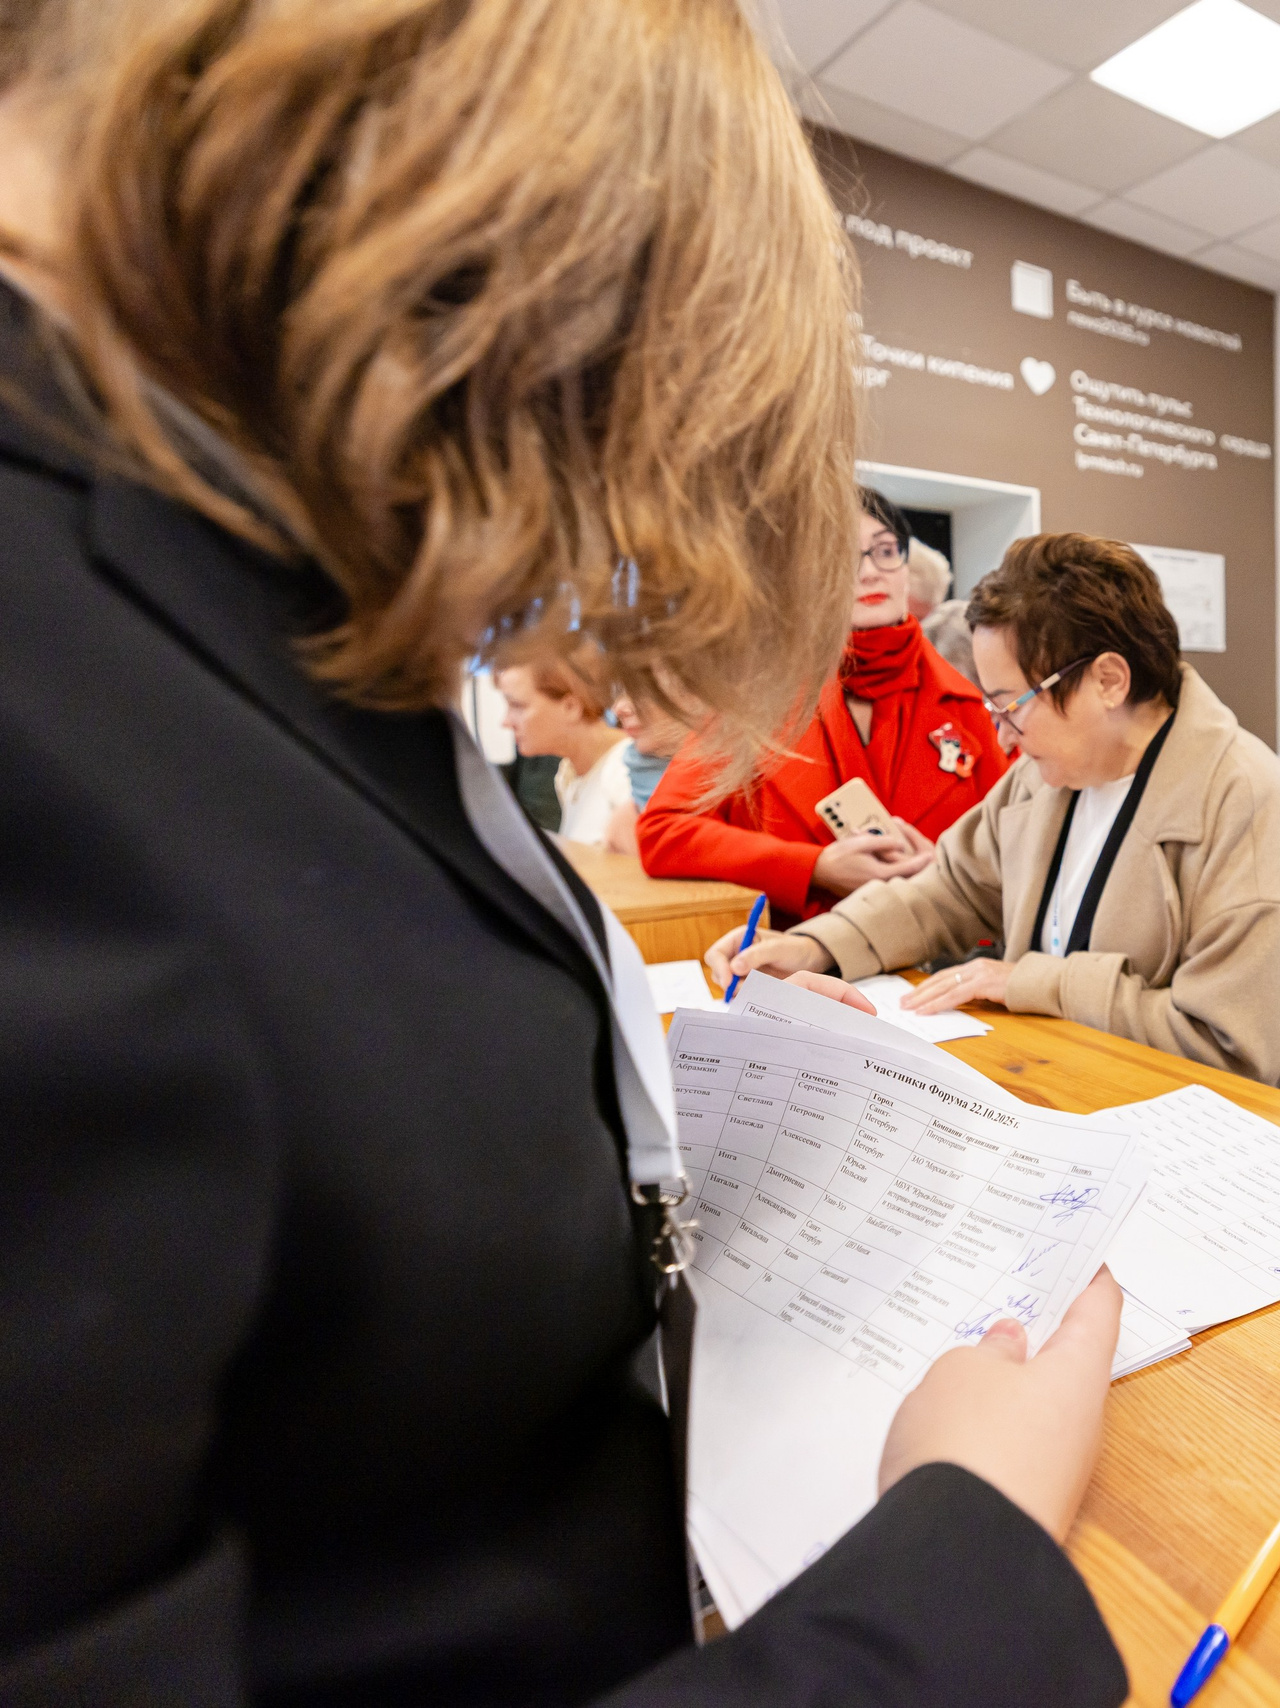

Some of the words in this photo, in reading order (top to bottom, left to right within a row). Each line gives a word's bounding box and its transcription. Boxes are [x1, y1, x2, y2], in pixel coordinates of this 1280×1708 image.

[679, 1053, 720, 1064] Фамилия
[676, 1063, 718, 1074] Абрамкин
[748, 1062, 767, 1071] Имя
[745, 1072, 764, 1081] Олег
[801, 1072, 839, 1087] Отчество
[798, 1081, 837, 1097] Сергеевич
[864, 1059, 926, 1091] Участники
[928, 1084, 969, 1109] Форума
[969, 1102, 1015, 1128] 22.10.2025
[737, 1094, 773, 1107] Светлана
[873, 1093, 894, 1107] Город
[789, 1104, 825, 1121] Петровна
[869, 1103, 892, 1118] Санкт-
[729, 1116, 764, 1129] Надежда
[865, 1113, 898, 1133] Петербург
[781, 1129, 822, 1149] Алексеевна
[858, 1129, 879, 1144] Санкт-
[932, 1119, 963, 1138] Компания
[965, 1133, 1000, 1152] организация
[718, 1150, 738, 1161] Инга
[853, 1139, 885, 1159] Петербург
[1010, 1150, 1040, 1164] Должность
[710, 1174, 739, 1190] Наталья
[766, 1166, 805, 1190] Дмитриевна
[699, 1202, 721, 1217] Ирина
[755, 1193, 797, 1220] Александровна
